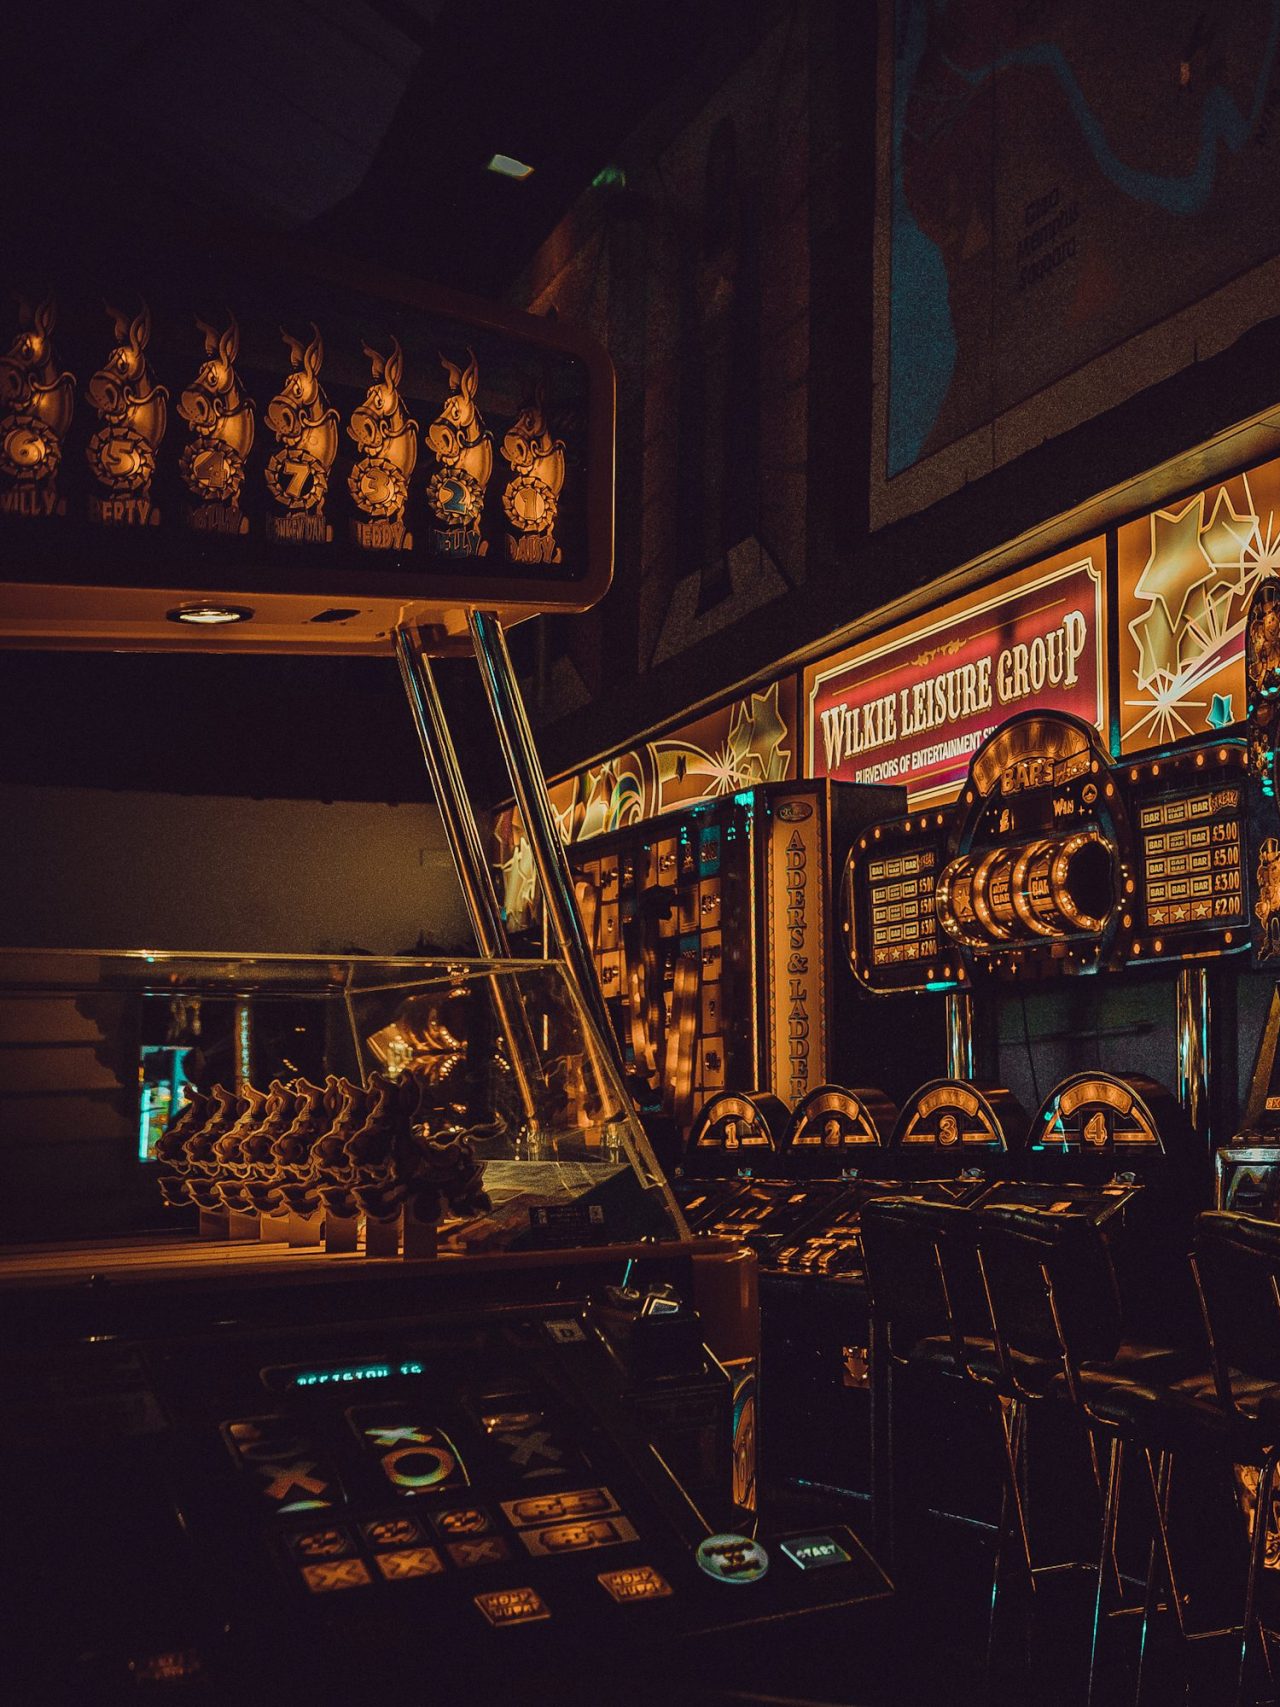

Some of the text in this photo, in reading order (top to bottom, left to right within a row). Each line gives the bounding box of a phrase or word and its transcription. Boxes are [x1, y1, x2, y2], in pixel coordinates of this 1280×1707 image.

[285, 462, 309, 497] 7
[443, 480, 468, 514] 2
[354, 519, 406, 549] EDDY
[855, 758, 899, 784] PURVEYORS
[899, 754, 911, 774] OF
[911, 734, 983, 770] ENTERTAINMENT
[1001, 758, 1055, 796] BARS
[1144, 812, 1160, 823] BAR
[1192, 801, 1208, 812] BAR
[1148, 840, 1163, 850] BAR
[1192, 831, 1206, 843] BAR
[1150, 846, 1239, 873] BAR BAR £5.00
[785, 830, 807, 949] ADDERS
[1150, 871, 1240, 897] BAR BAR BAR £3.00
[1215, 895, 1240, 916] £2.00
[787, 953, 809, 976] &
[789, 979, 809, 1106] LADDER
[725, 1122, 739, 1149] 1
[824, 1119, 841, 1146] 2
[938, 1115, 958, 1145] 3
[1083, 1112, 1108, 1145] 4
